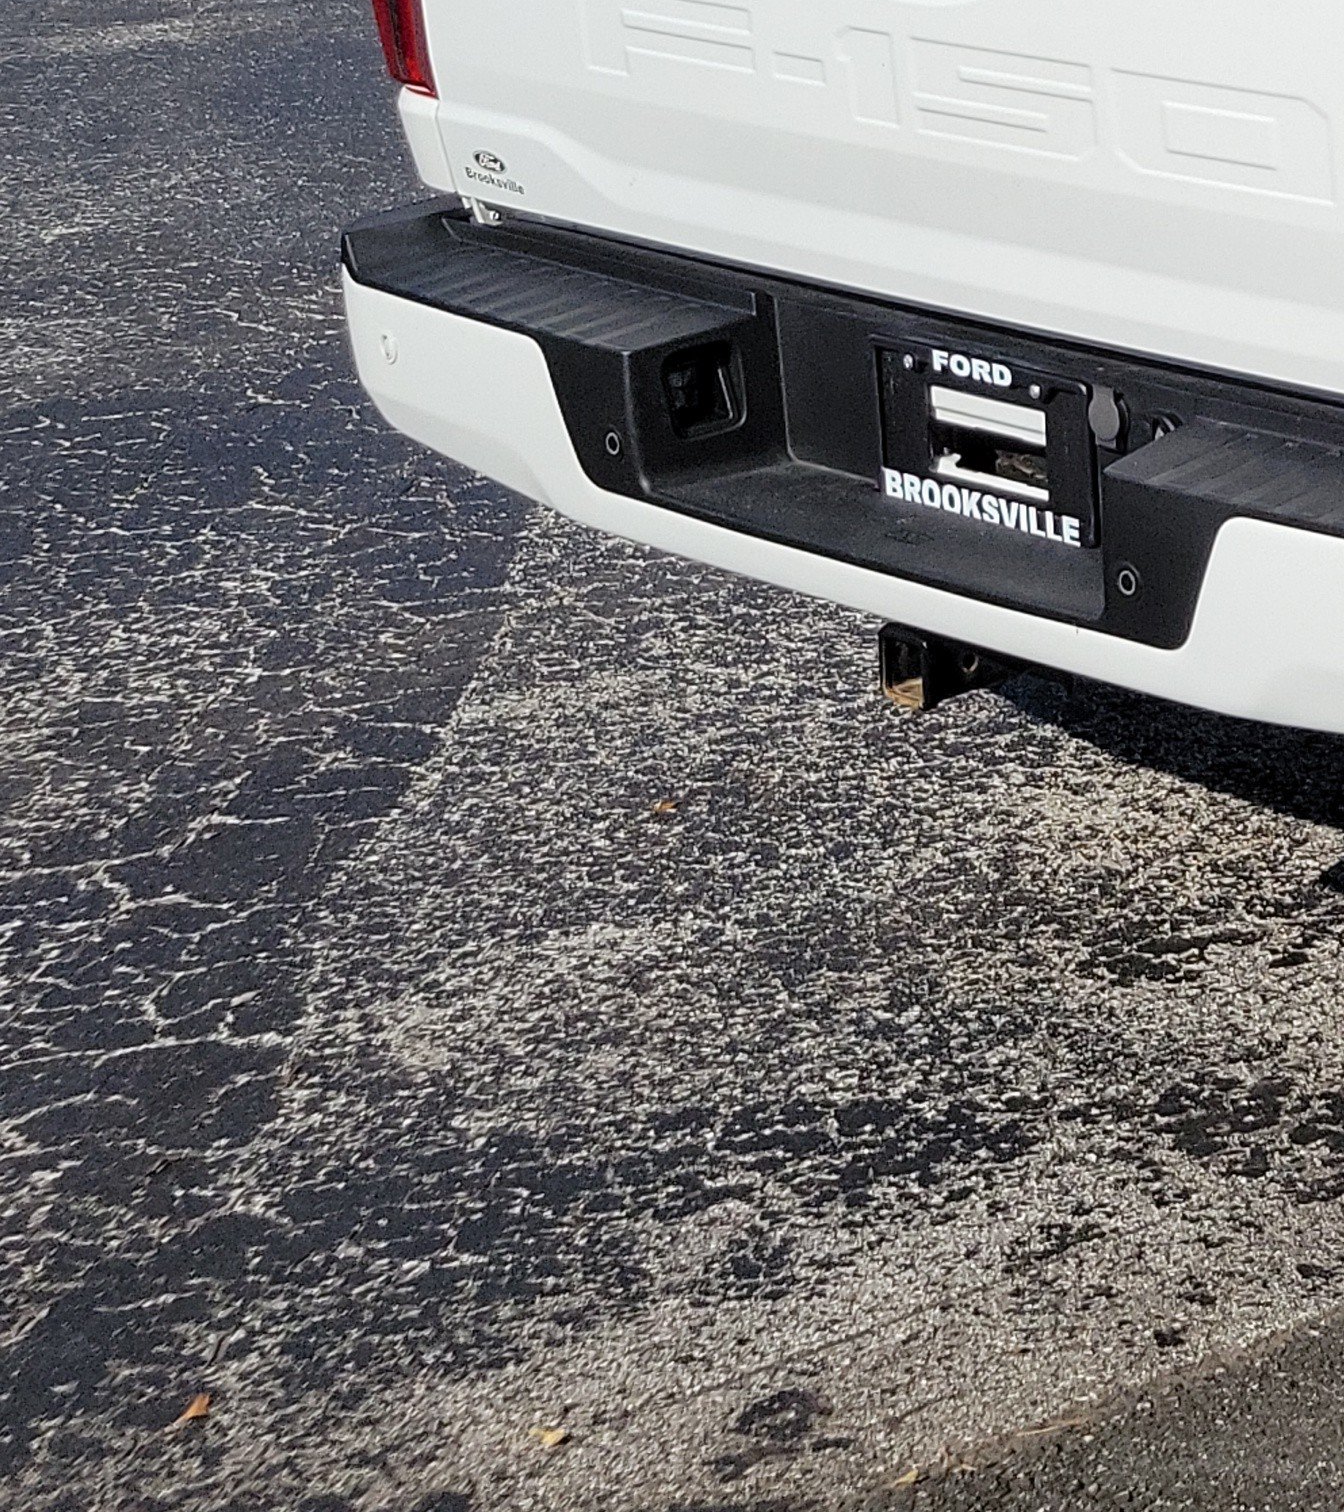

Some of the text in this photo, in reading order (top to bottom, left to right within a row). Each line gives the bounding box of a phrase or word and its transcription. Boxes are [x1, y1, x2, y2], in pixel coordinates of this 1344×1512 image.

[465, 166, 525, 196] Brooksville
[931, 348, 1013, 387] FORD
[881, 465, 1082, 548] BROOKSVILLE
